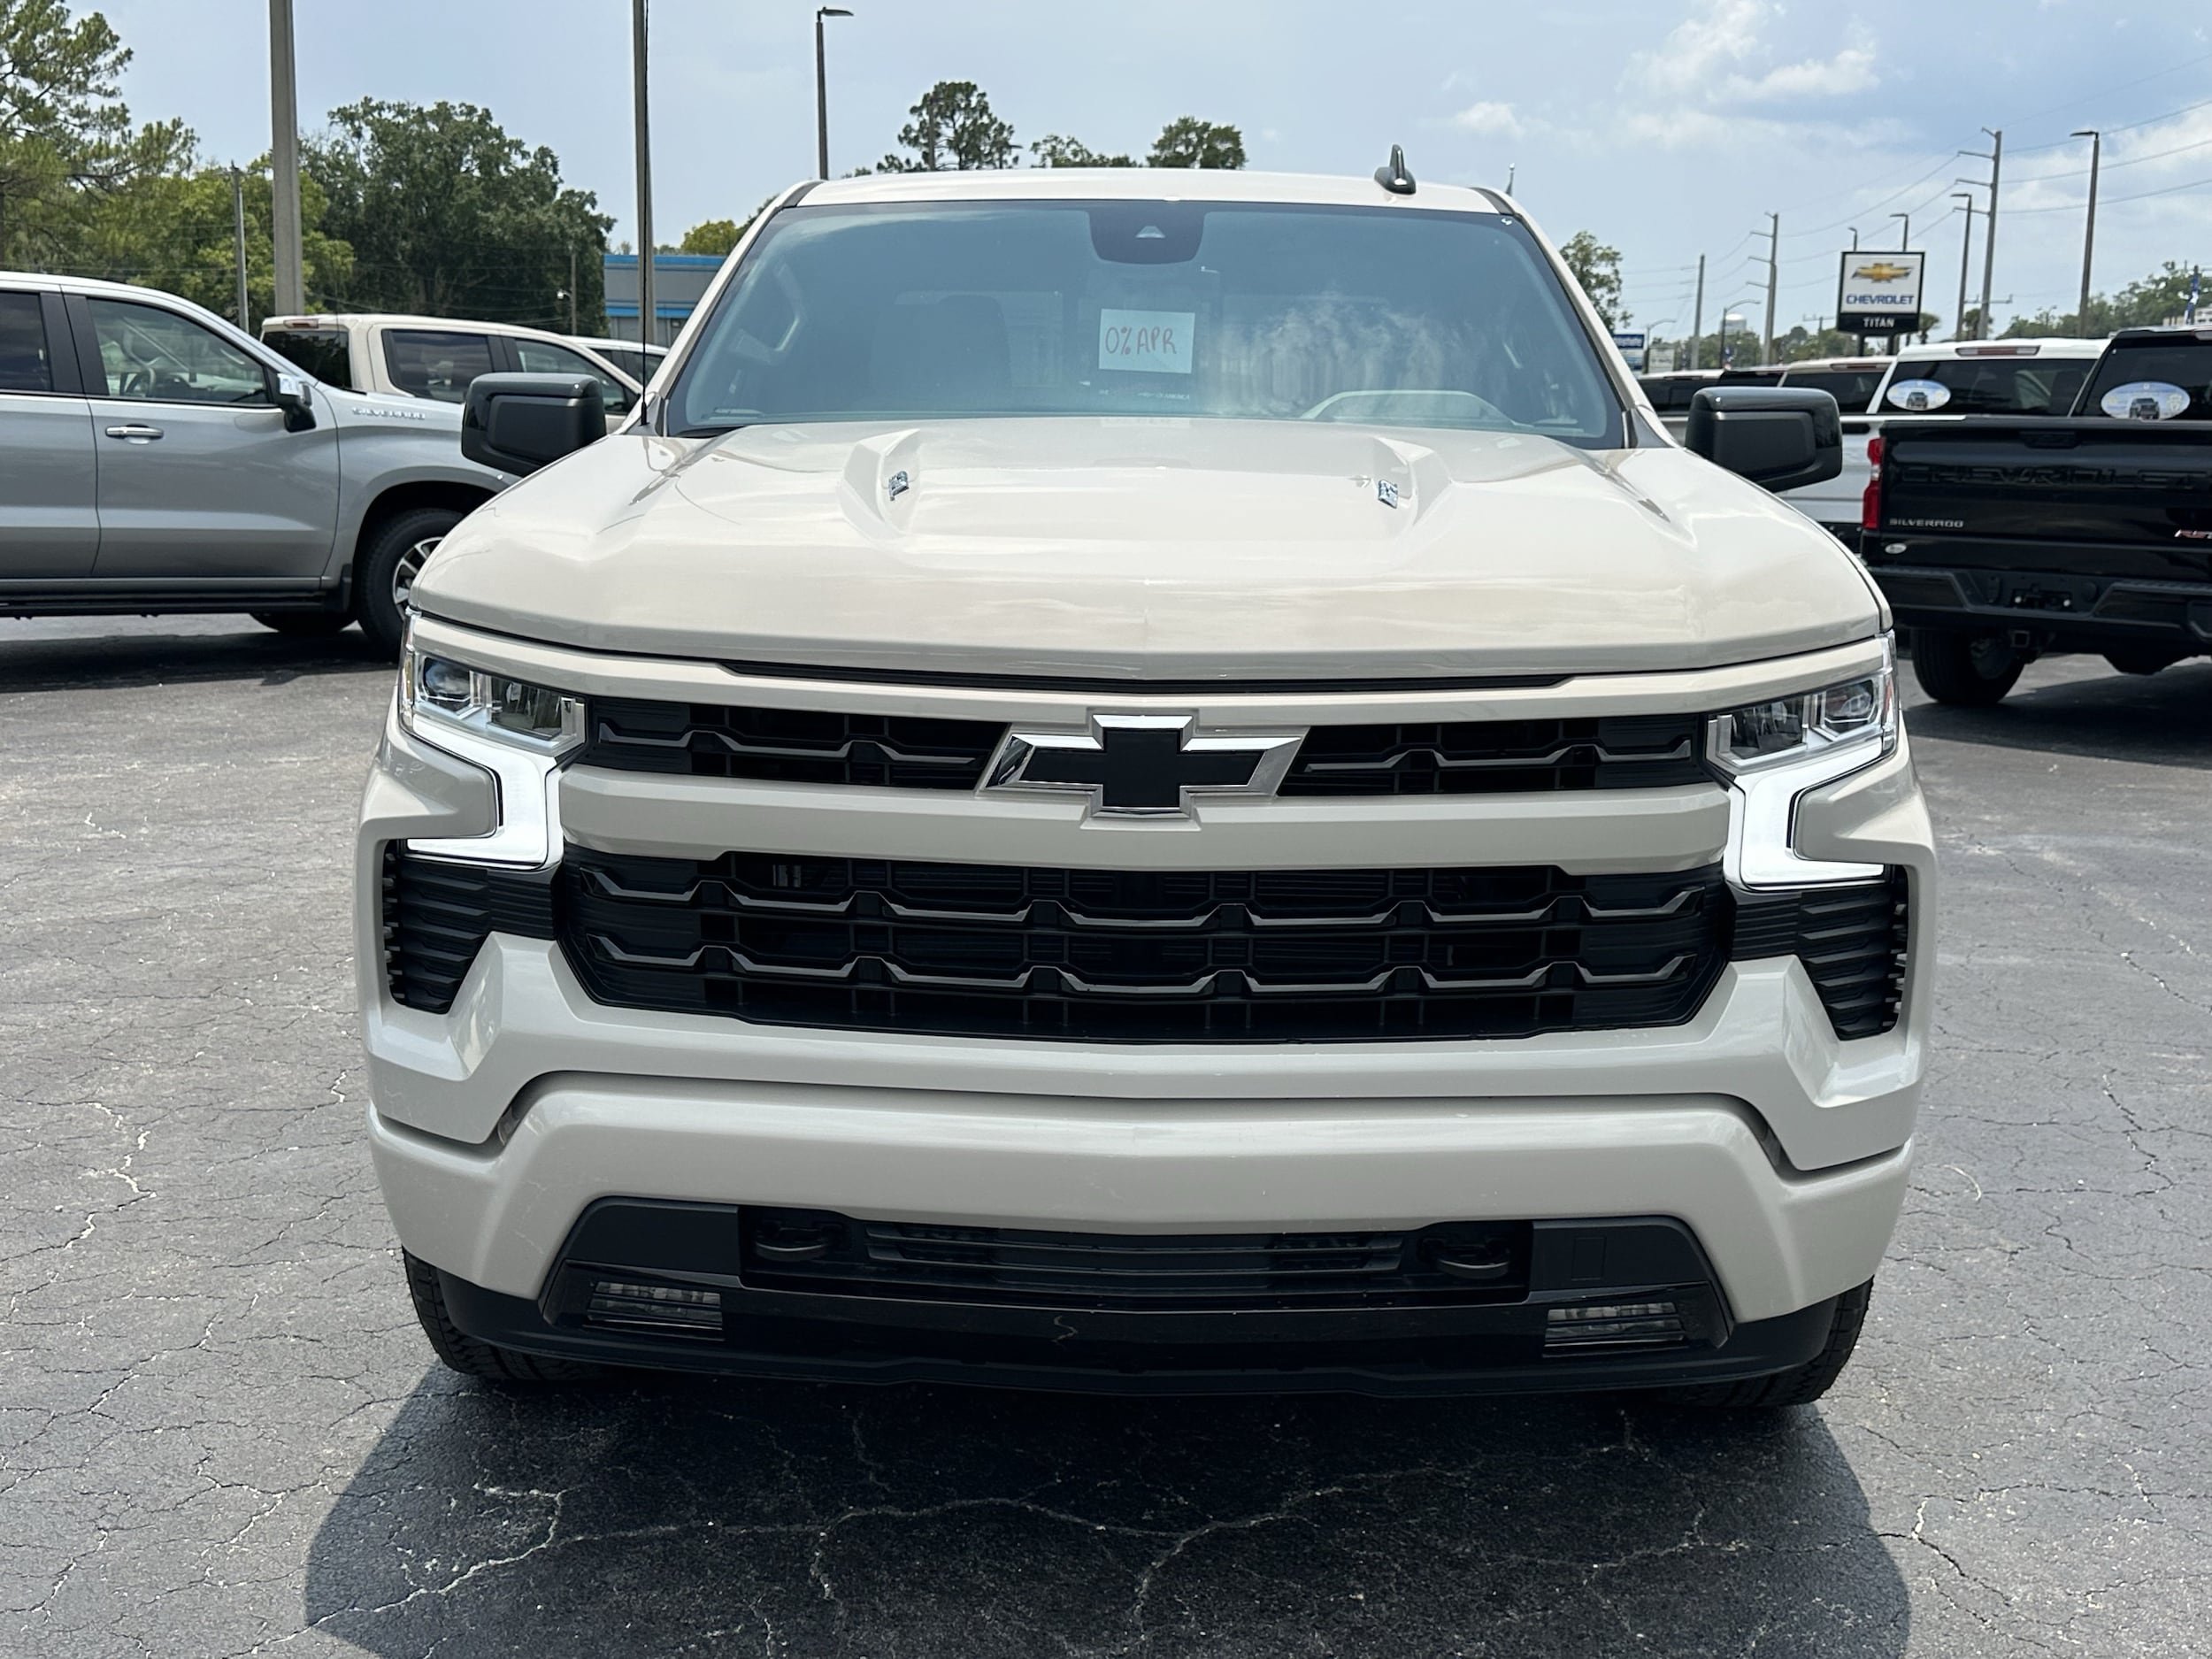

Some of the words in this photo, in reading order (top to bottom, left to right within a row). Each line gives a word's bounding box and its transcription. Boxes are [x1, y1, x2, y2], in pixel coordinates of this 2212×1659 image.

[1846, 295, 1915, 305] CHEVROLET
[1863, 317, 1894, 328] TITAN
[1105, 326, 1132, 355] 0%
[1136, 326, 1177, 355] APR
[1889, 518, 1964, 528] SILVERADO
